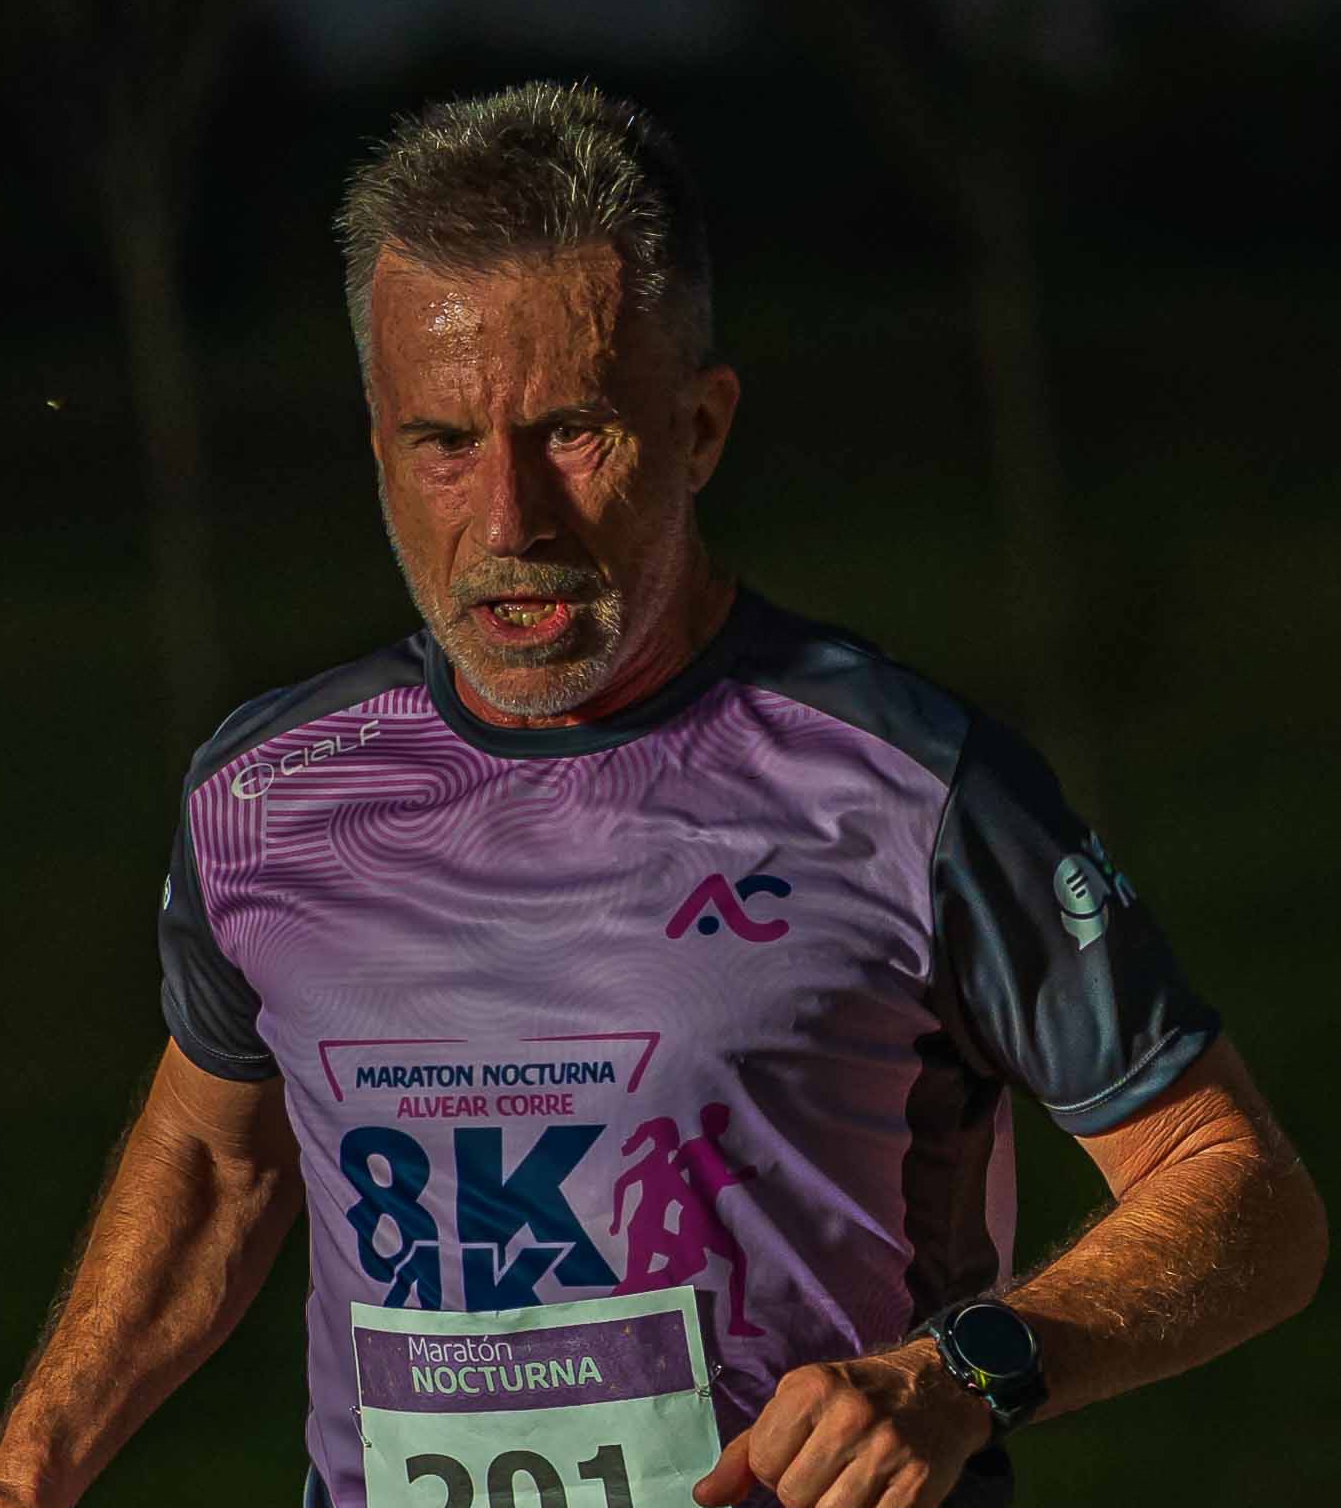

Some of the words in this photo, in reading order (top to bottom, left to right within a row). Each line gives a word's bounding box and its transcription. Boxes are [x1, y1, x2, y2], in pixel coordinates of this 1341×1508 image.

[355, 1066, 473, 1088] MARATON
[482, 1061, 616, 1086] NOCTURNA
[397, 1097, 489, 1118] ALVEAR
[496, 1093, 574, 1116] CORRE
[340, 1124, 622, 1287] 8K
[409, 1335, 513, 1362] Maratón
[411, 1356, 603, 1394] NOCTURNA
